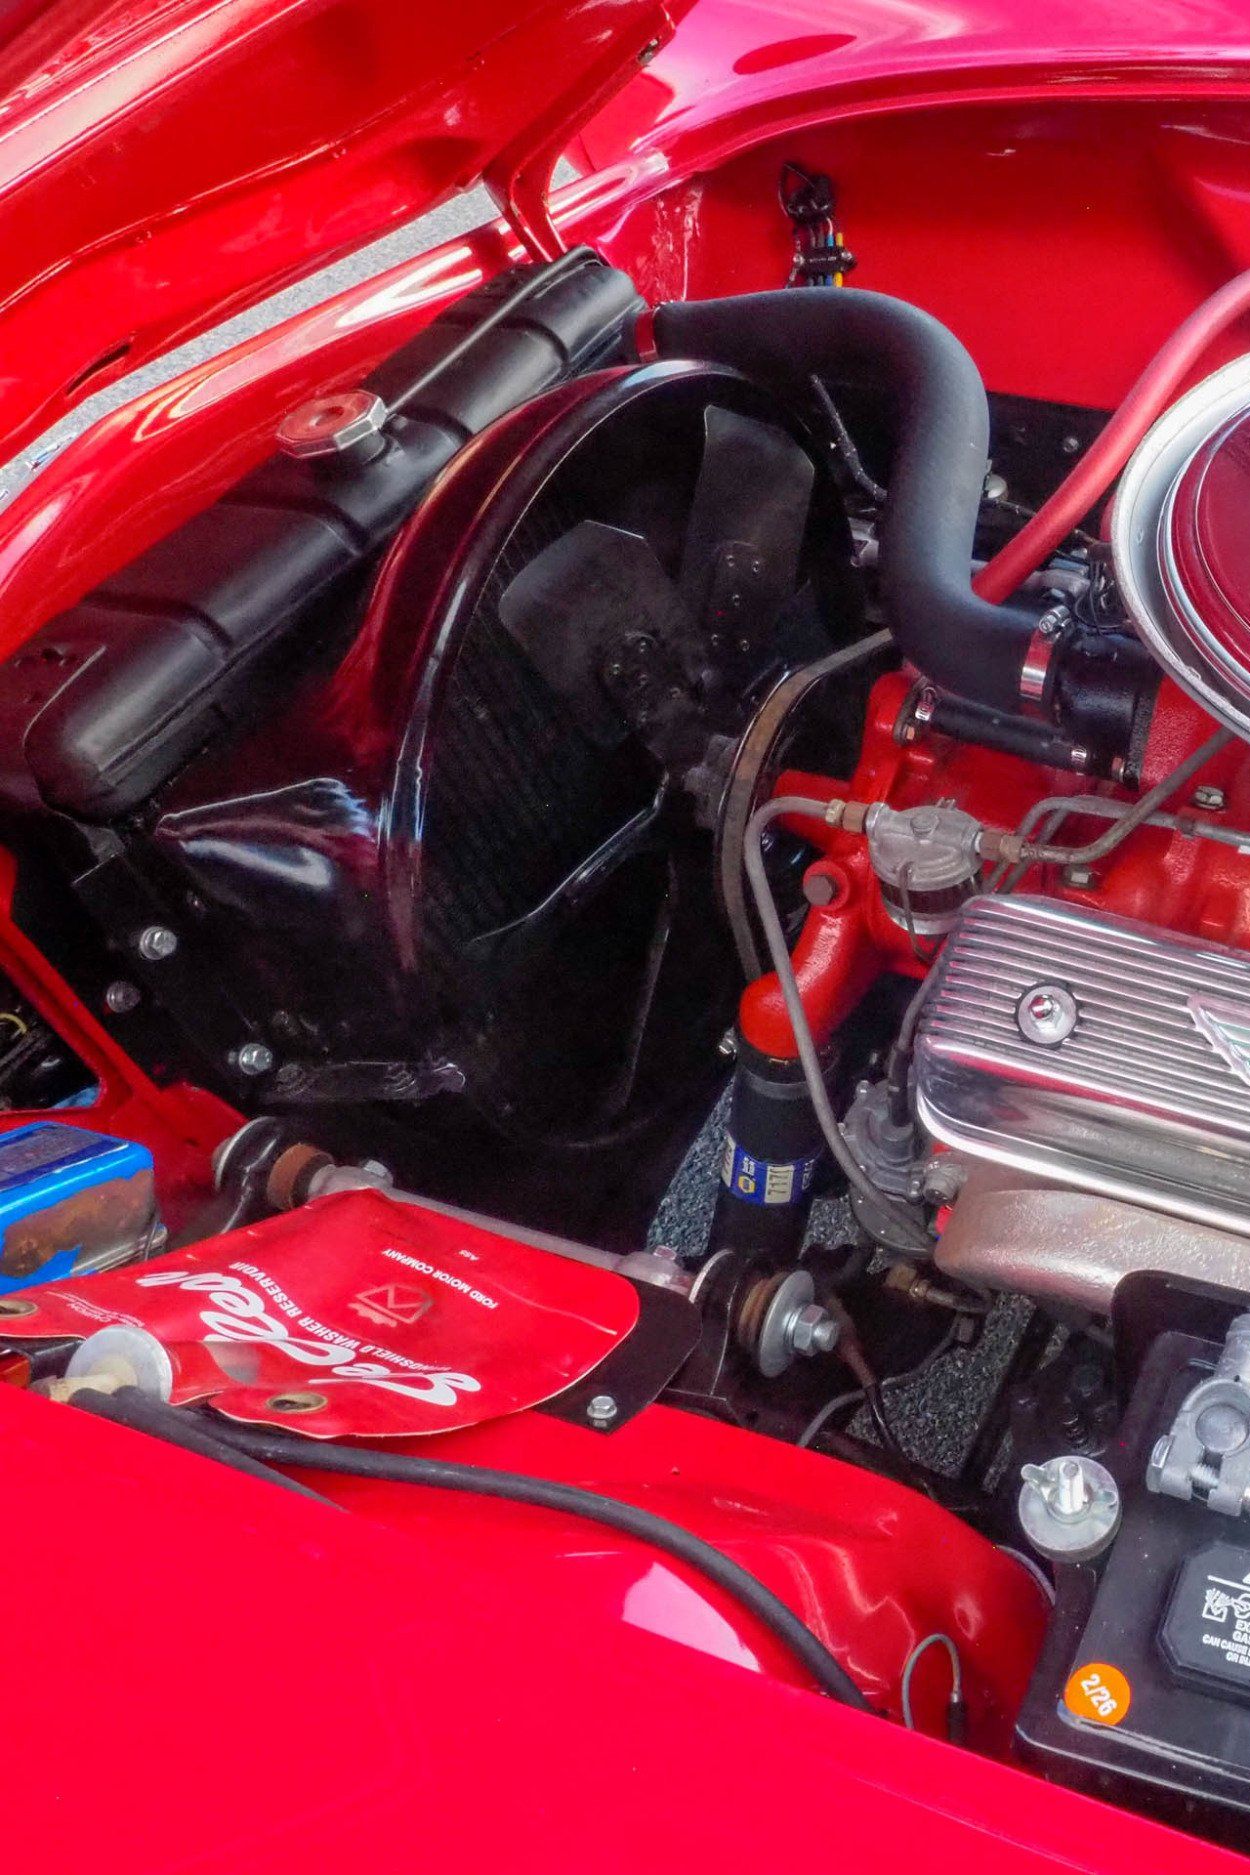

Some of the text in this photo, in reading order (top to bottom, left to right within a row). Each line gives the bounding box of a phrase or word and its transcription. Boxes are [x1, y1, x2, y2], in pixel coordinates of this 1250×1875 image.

[228, 1261, 309, 1321] RESERVOIR
[381, 1248, 500, 1309] FORD MOTOR COMPANY
[298, 1315, 360, 1352] WASHER
[1202, 1634, 1220, 1647] CAN
[1081, 1674, 1117, 1717] 2/26
